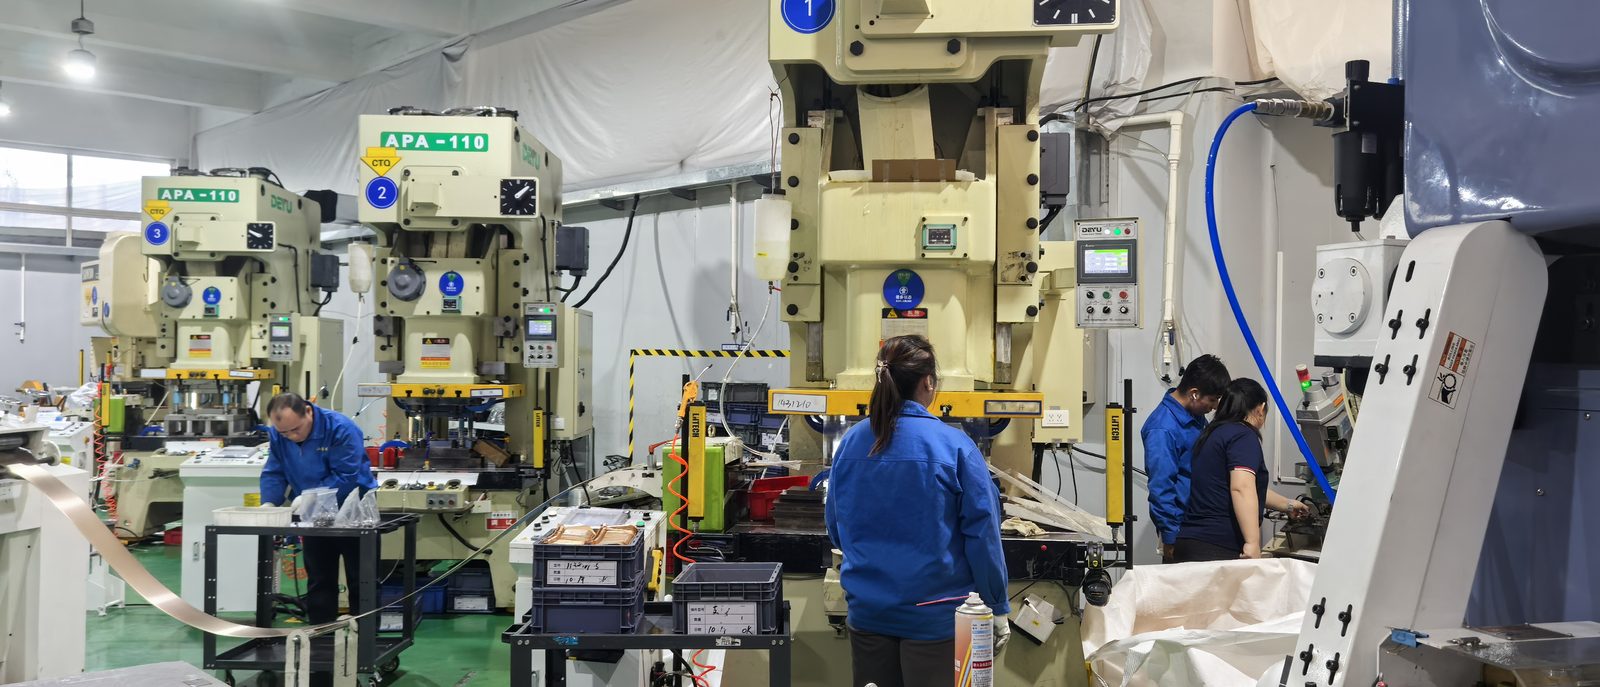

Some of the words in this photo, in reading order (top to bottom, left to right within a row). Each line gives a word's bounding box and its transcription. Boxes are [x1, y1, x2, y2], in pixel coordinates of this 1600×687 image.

[804, 0, 812, 17] 1
[384, 133, 429, 149] APA
[436, 135, 485, 149] -110
[371, 159, 391, 167] CTQ
[161, 189, 195, 200] APA
[377, 186, 386, 200] 2
[153, 228, 161, 239] 3
